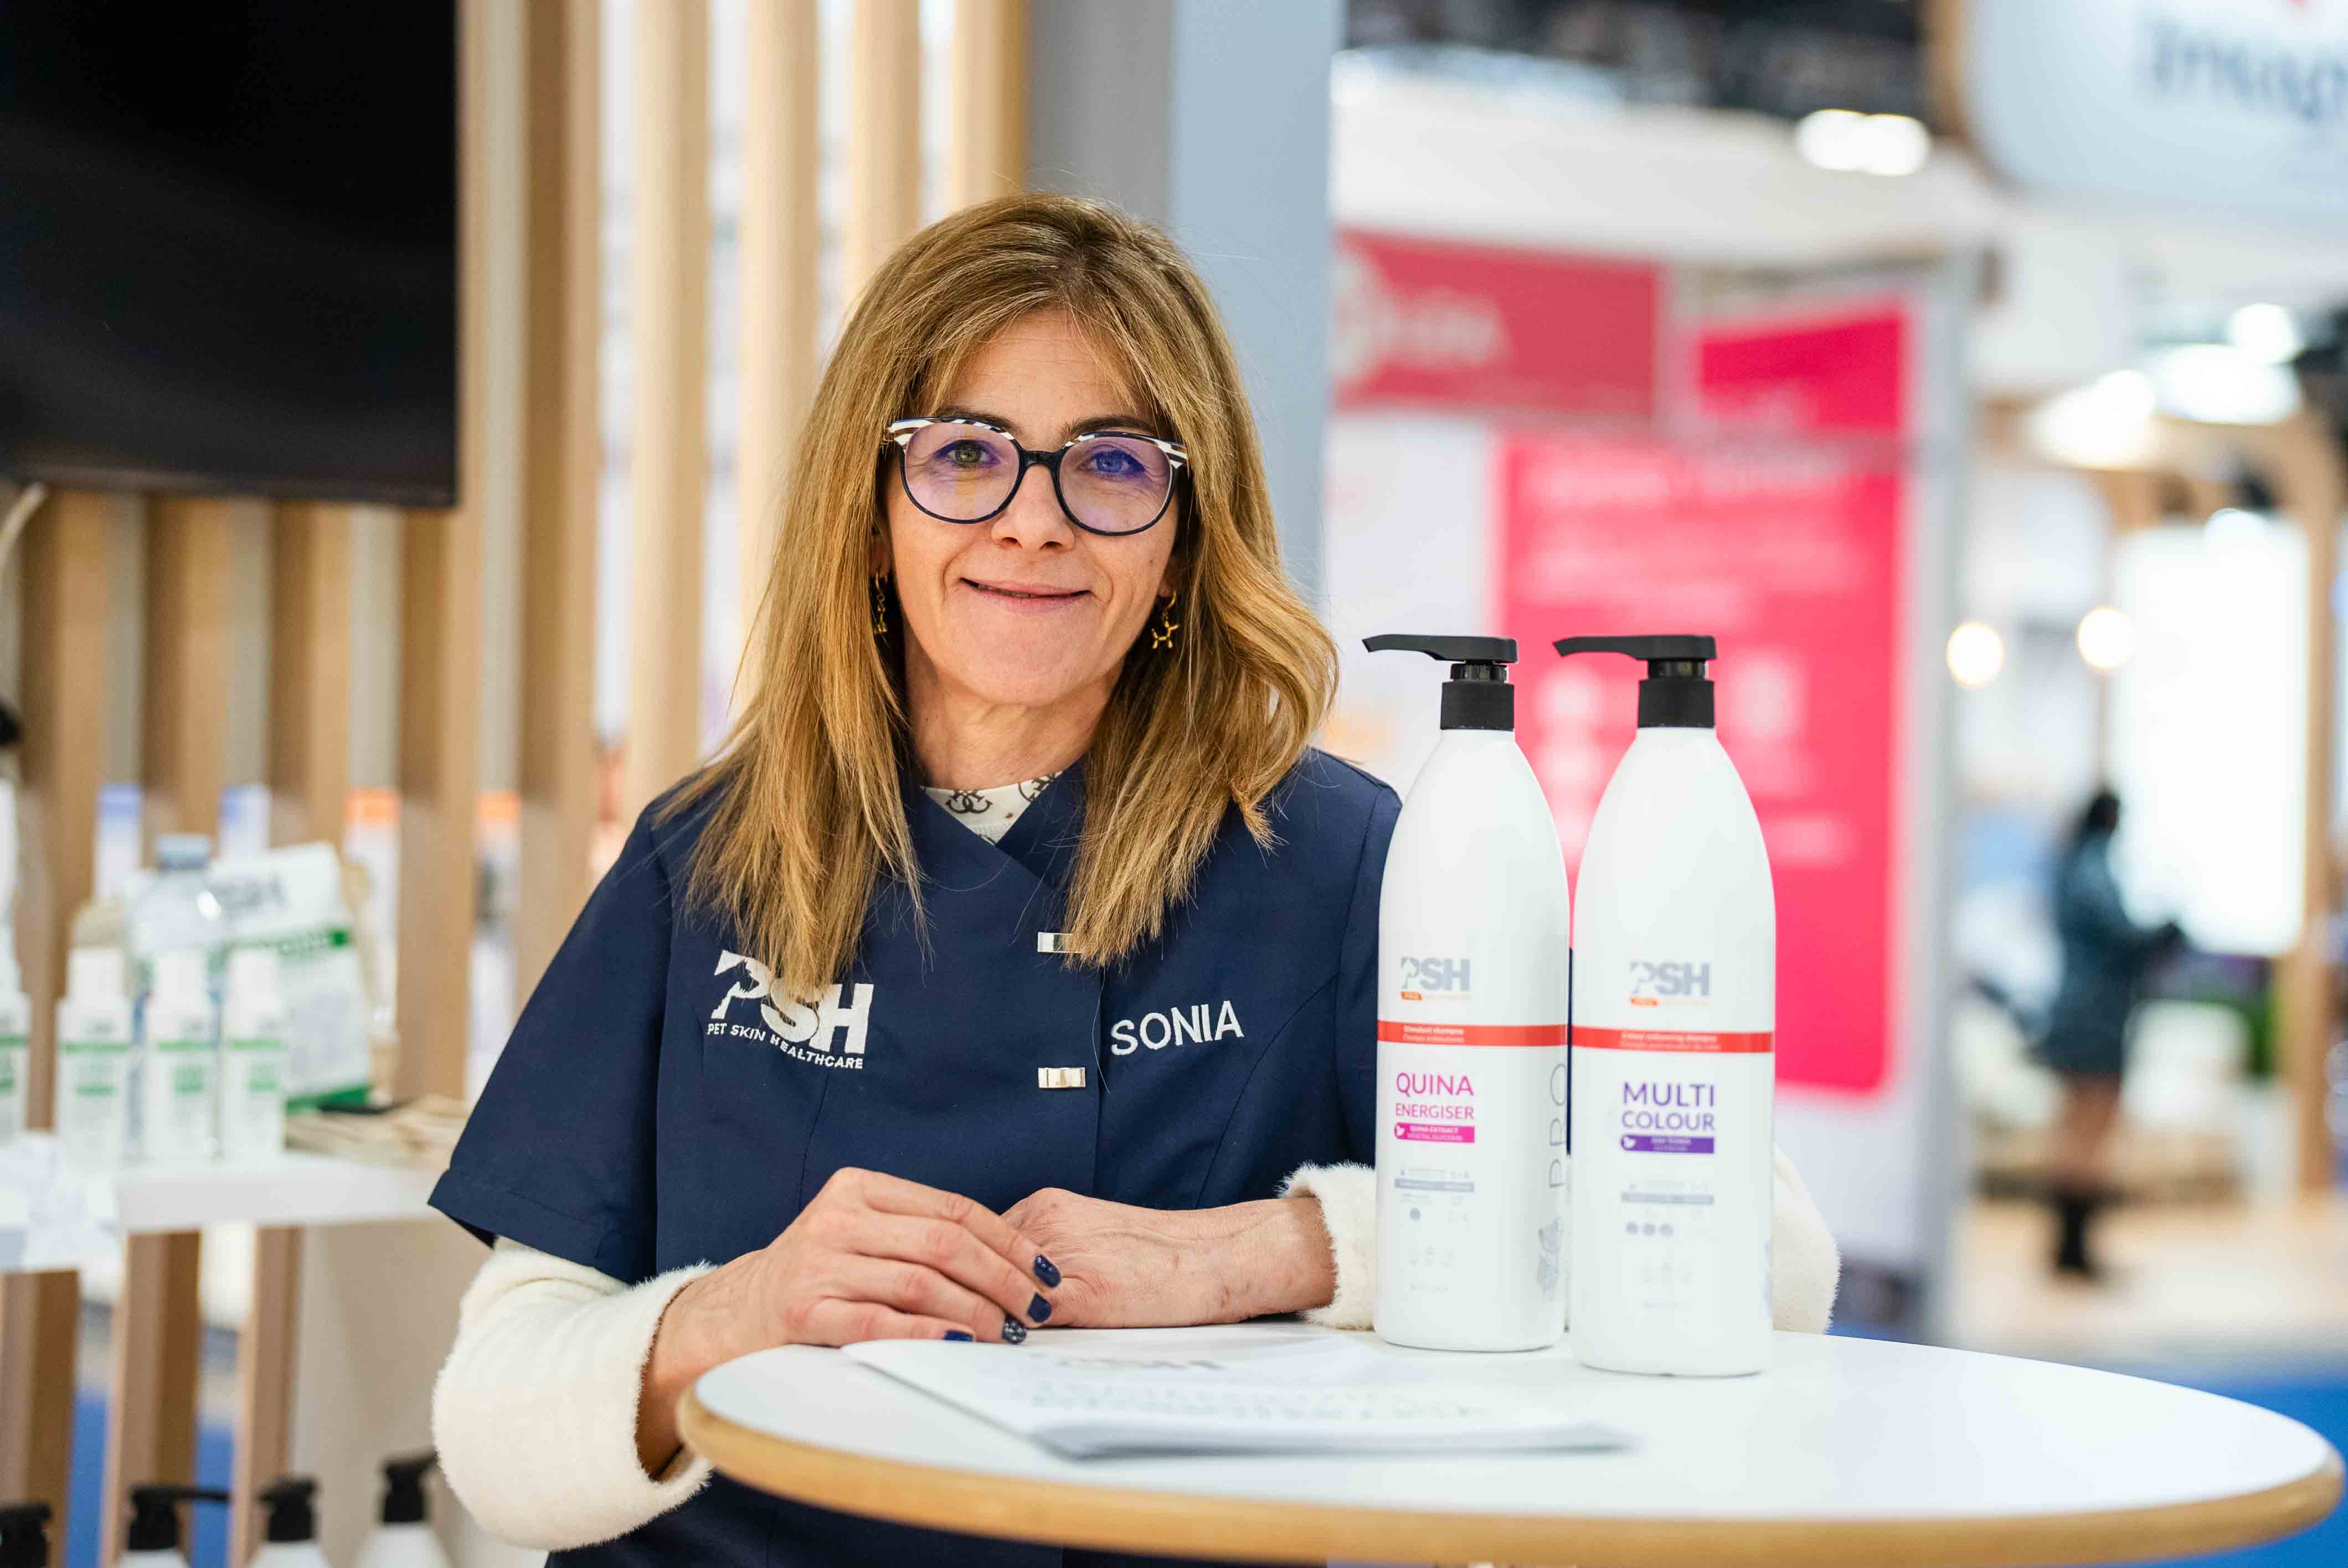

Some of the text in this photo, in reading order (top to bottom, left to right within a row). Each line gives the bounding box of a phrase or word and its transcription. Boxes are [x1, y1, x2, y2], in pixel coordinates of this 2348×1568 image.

[1400, 956, 1471, 992] PSH
[1630, 961, 1711, 997] PSH
[711, 950, 874, 1054] PSH
[1111, 1000, 1244, 1055] SONIA
[707, 1023, 863, 1069] PET SKIN HEALTHCARE
[1396, 1072, 1474, 1097] QUINA
[1623, 1081, 1714, 1107] MULTI
[1395, 1102, 1475, 1120] ENERGISER
[1622, 1110, 1716, 1131] COLOUR
